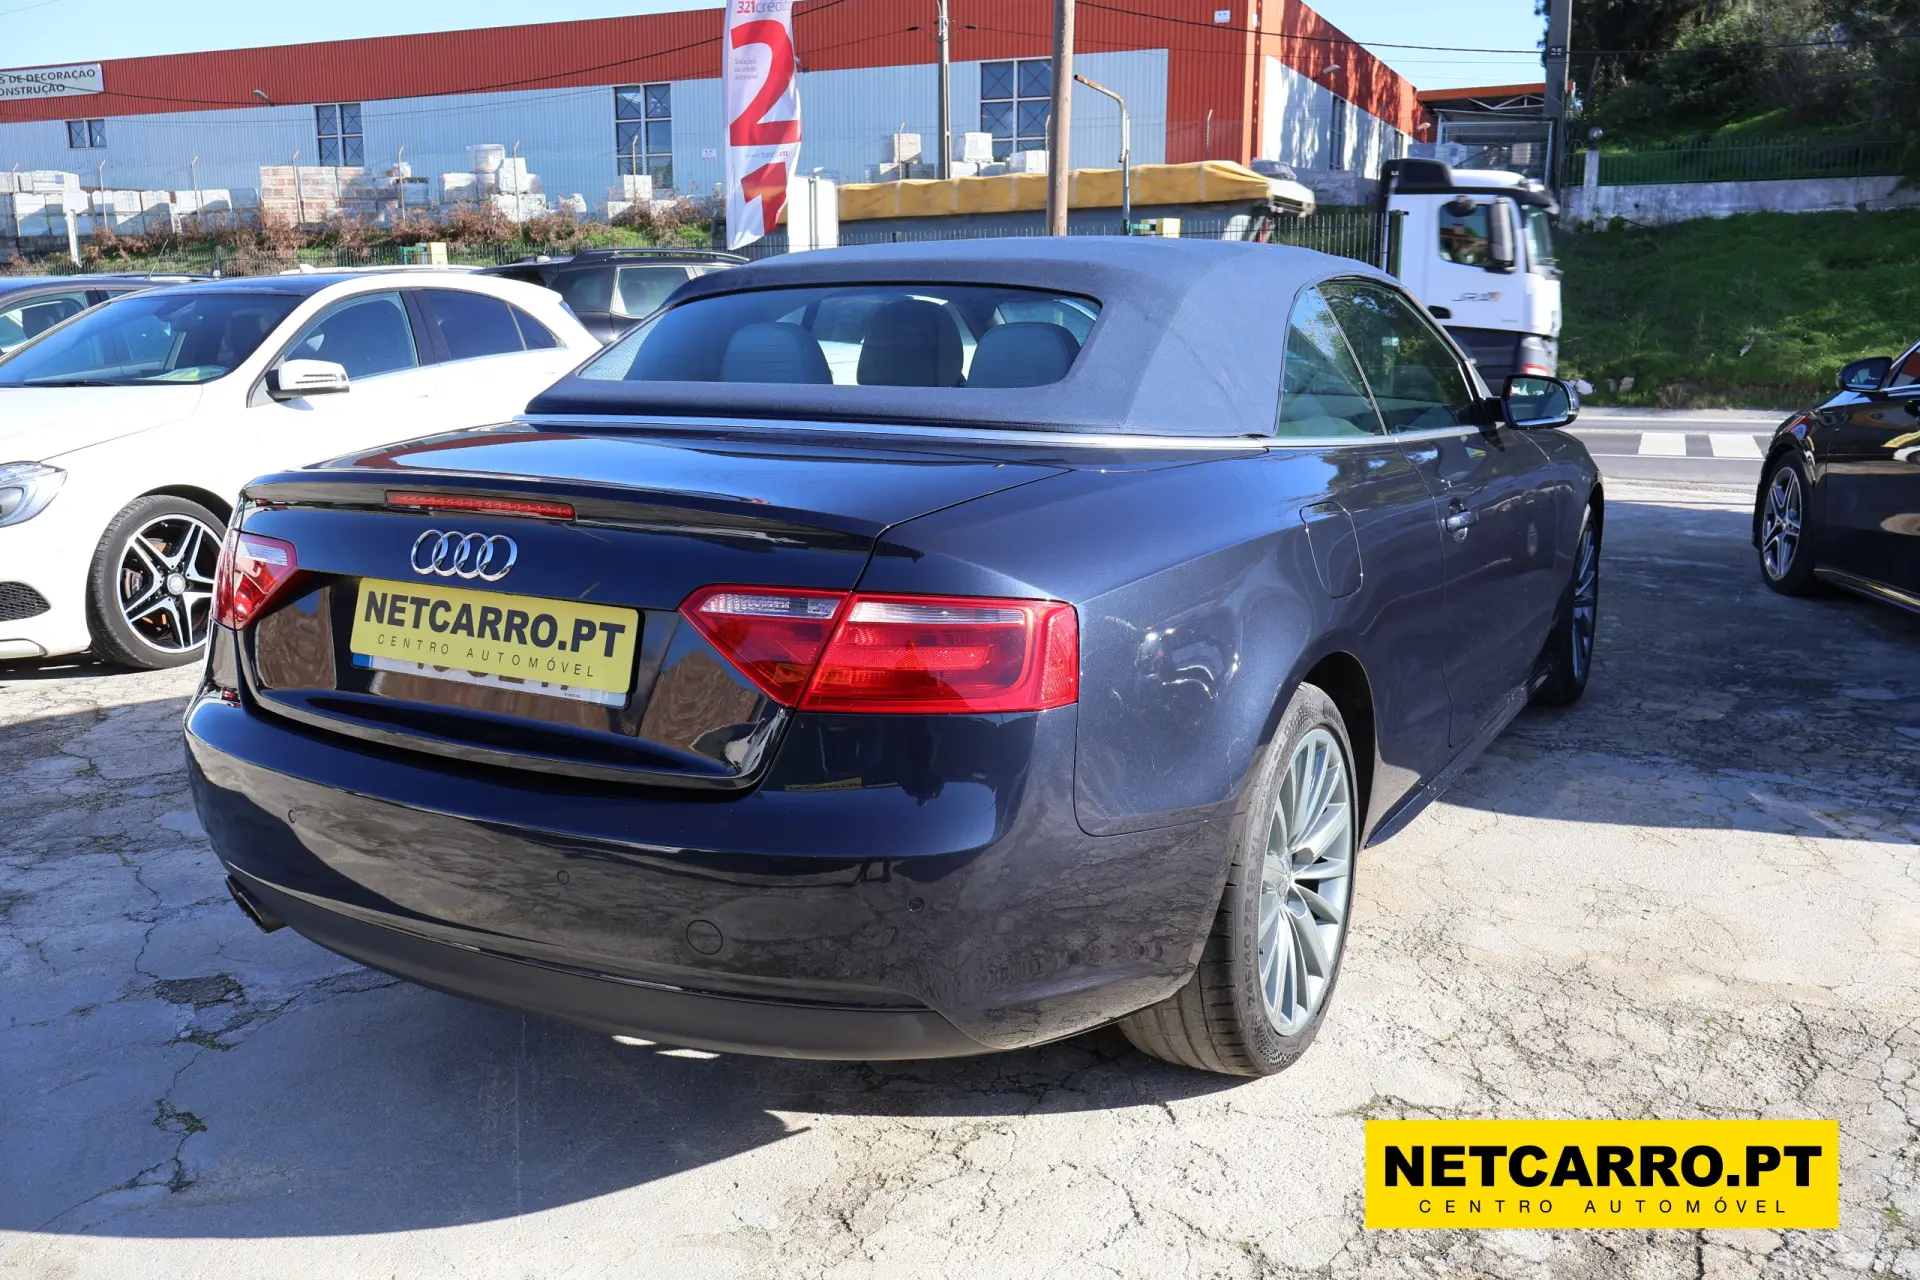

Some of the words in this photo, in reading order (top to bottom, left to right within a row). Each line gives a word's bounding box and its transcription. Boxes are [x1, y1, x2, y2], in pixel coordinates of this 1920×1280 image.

[9, 74, 23, 84] DE
[26, 67, 95, 82] DECORAÇÃO
[364, 590, 626, 659] NETCARRO.PT
[378, 633, 449, 655] CENTRO
[466, 647, 594, 678] AUTOMÓVEL
